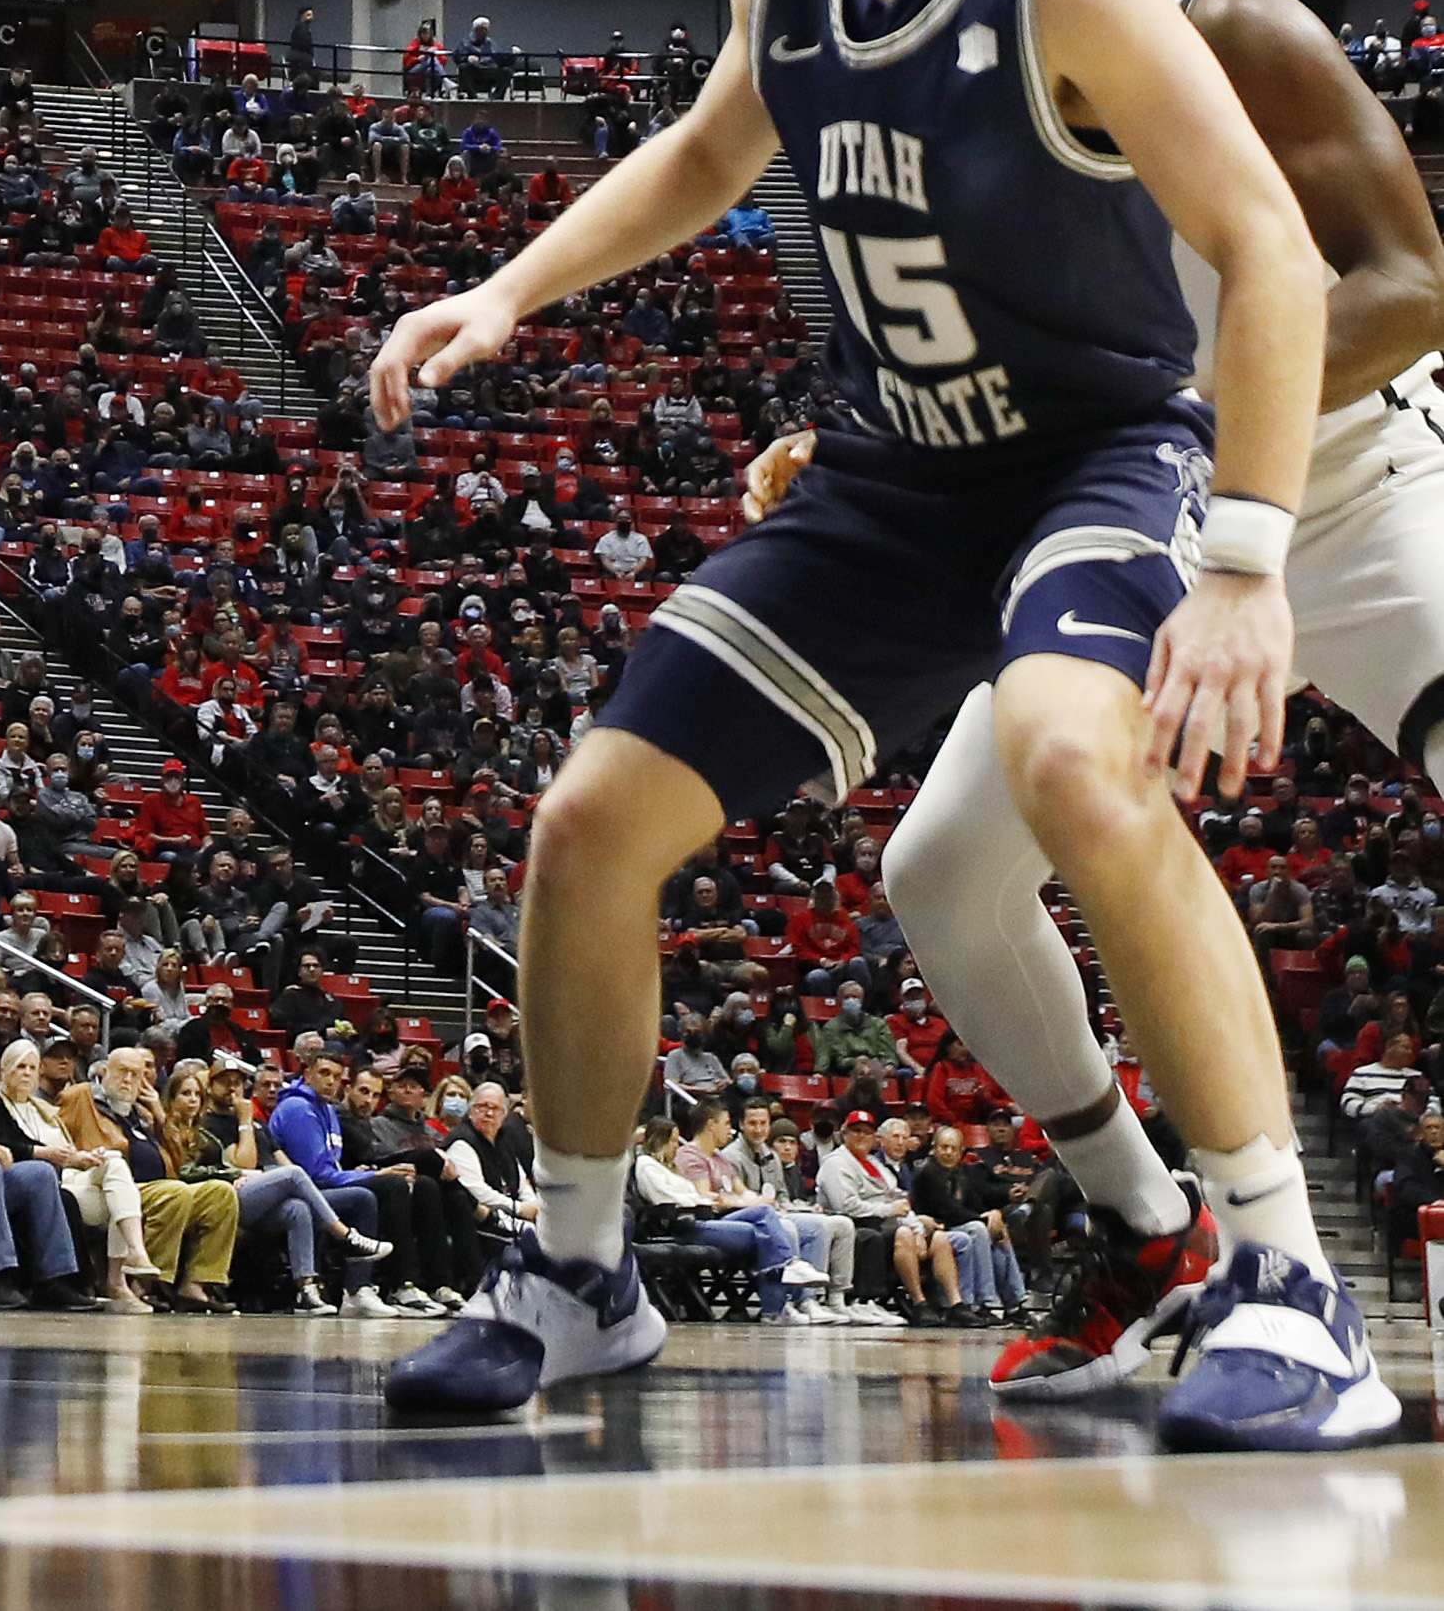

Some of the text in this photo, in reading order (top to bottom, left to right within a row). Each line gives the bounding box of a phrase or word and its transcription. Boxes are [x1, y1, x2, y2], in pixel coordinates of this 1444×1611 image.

[145, 34, 164, 57] C
[817, 119, 930, 214] UTAH
[819, 223, 979, 370] 15
[877, 363, 1027, 448] STATE
